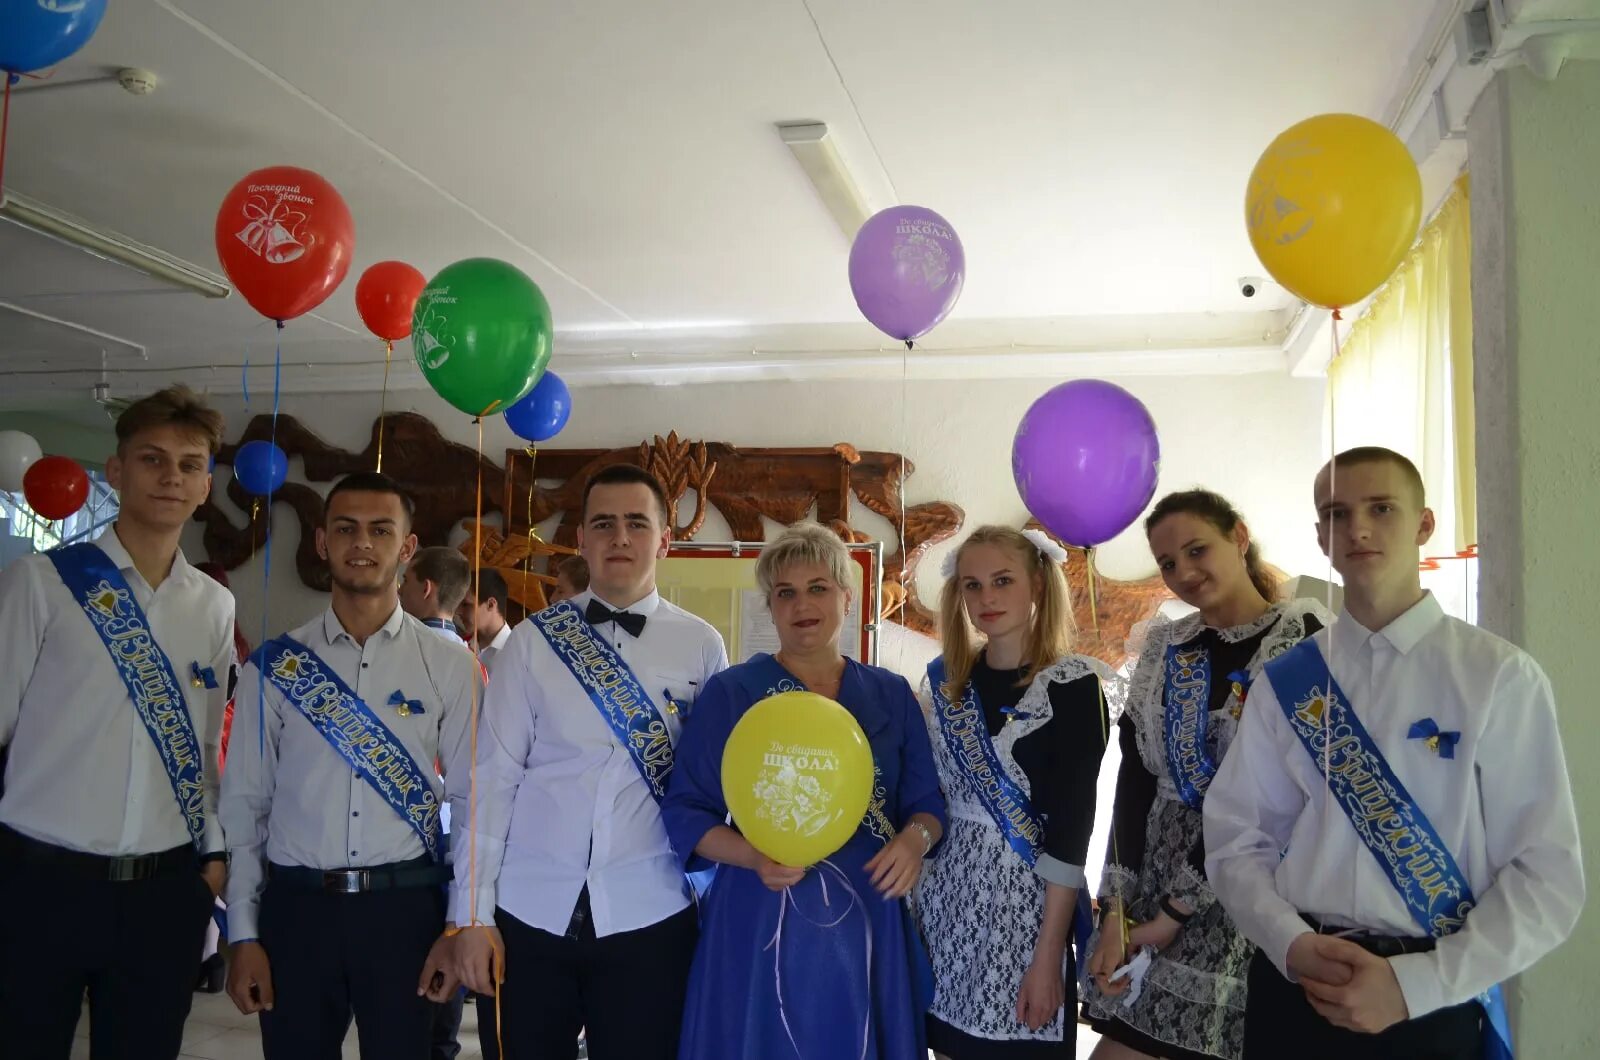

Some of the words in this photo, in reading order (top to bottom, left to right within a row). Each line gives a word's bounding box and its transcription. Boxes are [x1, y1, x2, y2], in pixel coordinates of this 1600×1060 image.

[276, 192, 314, 205] звонок
[895, 225, 953, 241] ШКОЛА!
[103, 617, 194, 778] Выпускник
[538, 603, 646, 731] Выпускник
[291, 673, 418, 807] Выпускник
[763, 753, 839, 771] ШКОЛА!
[943, 700, 1040, 846] Выпускница
[1310, 724, 1453, 914] Выпускник
